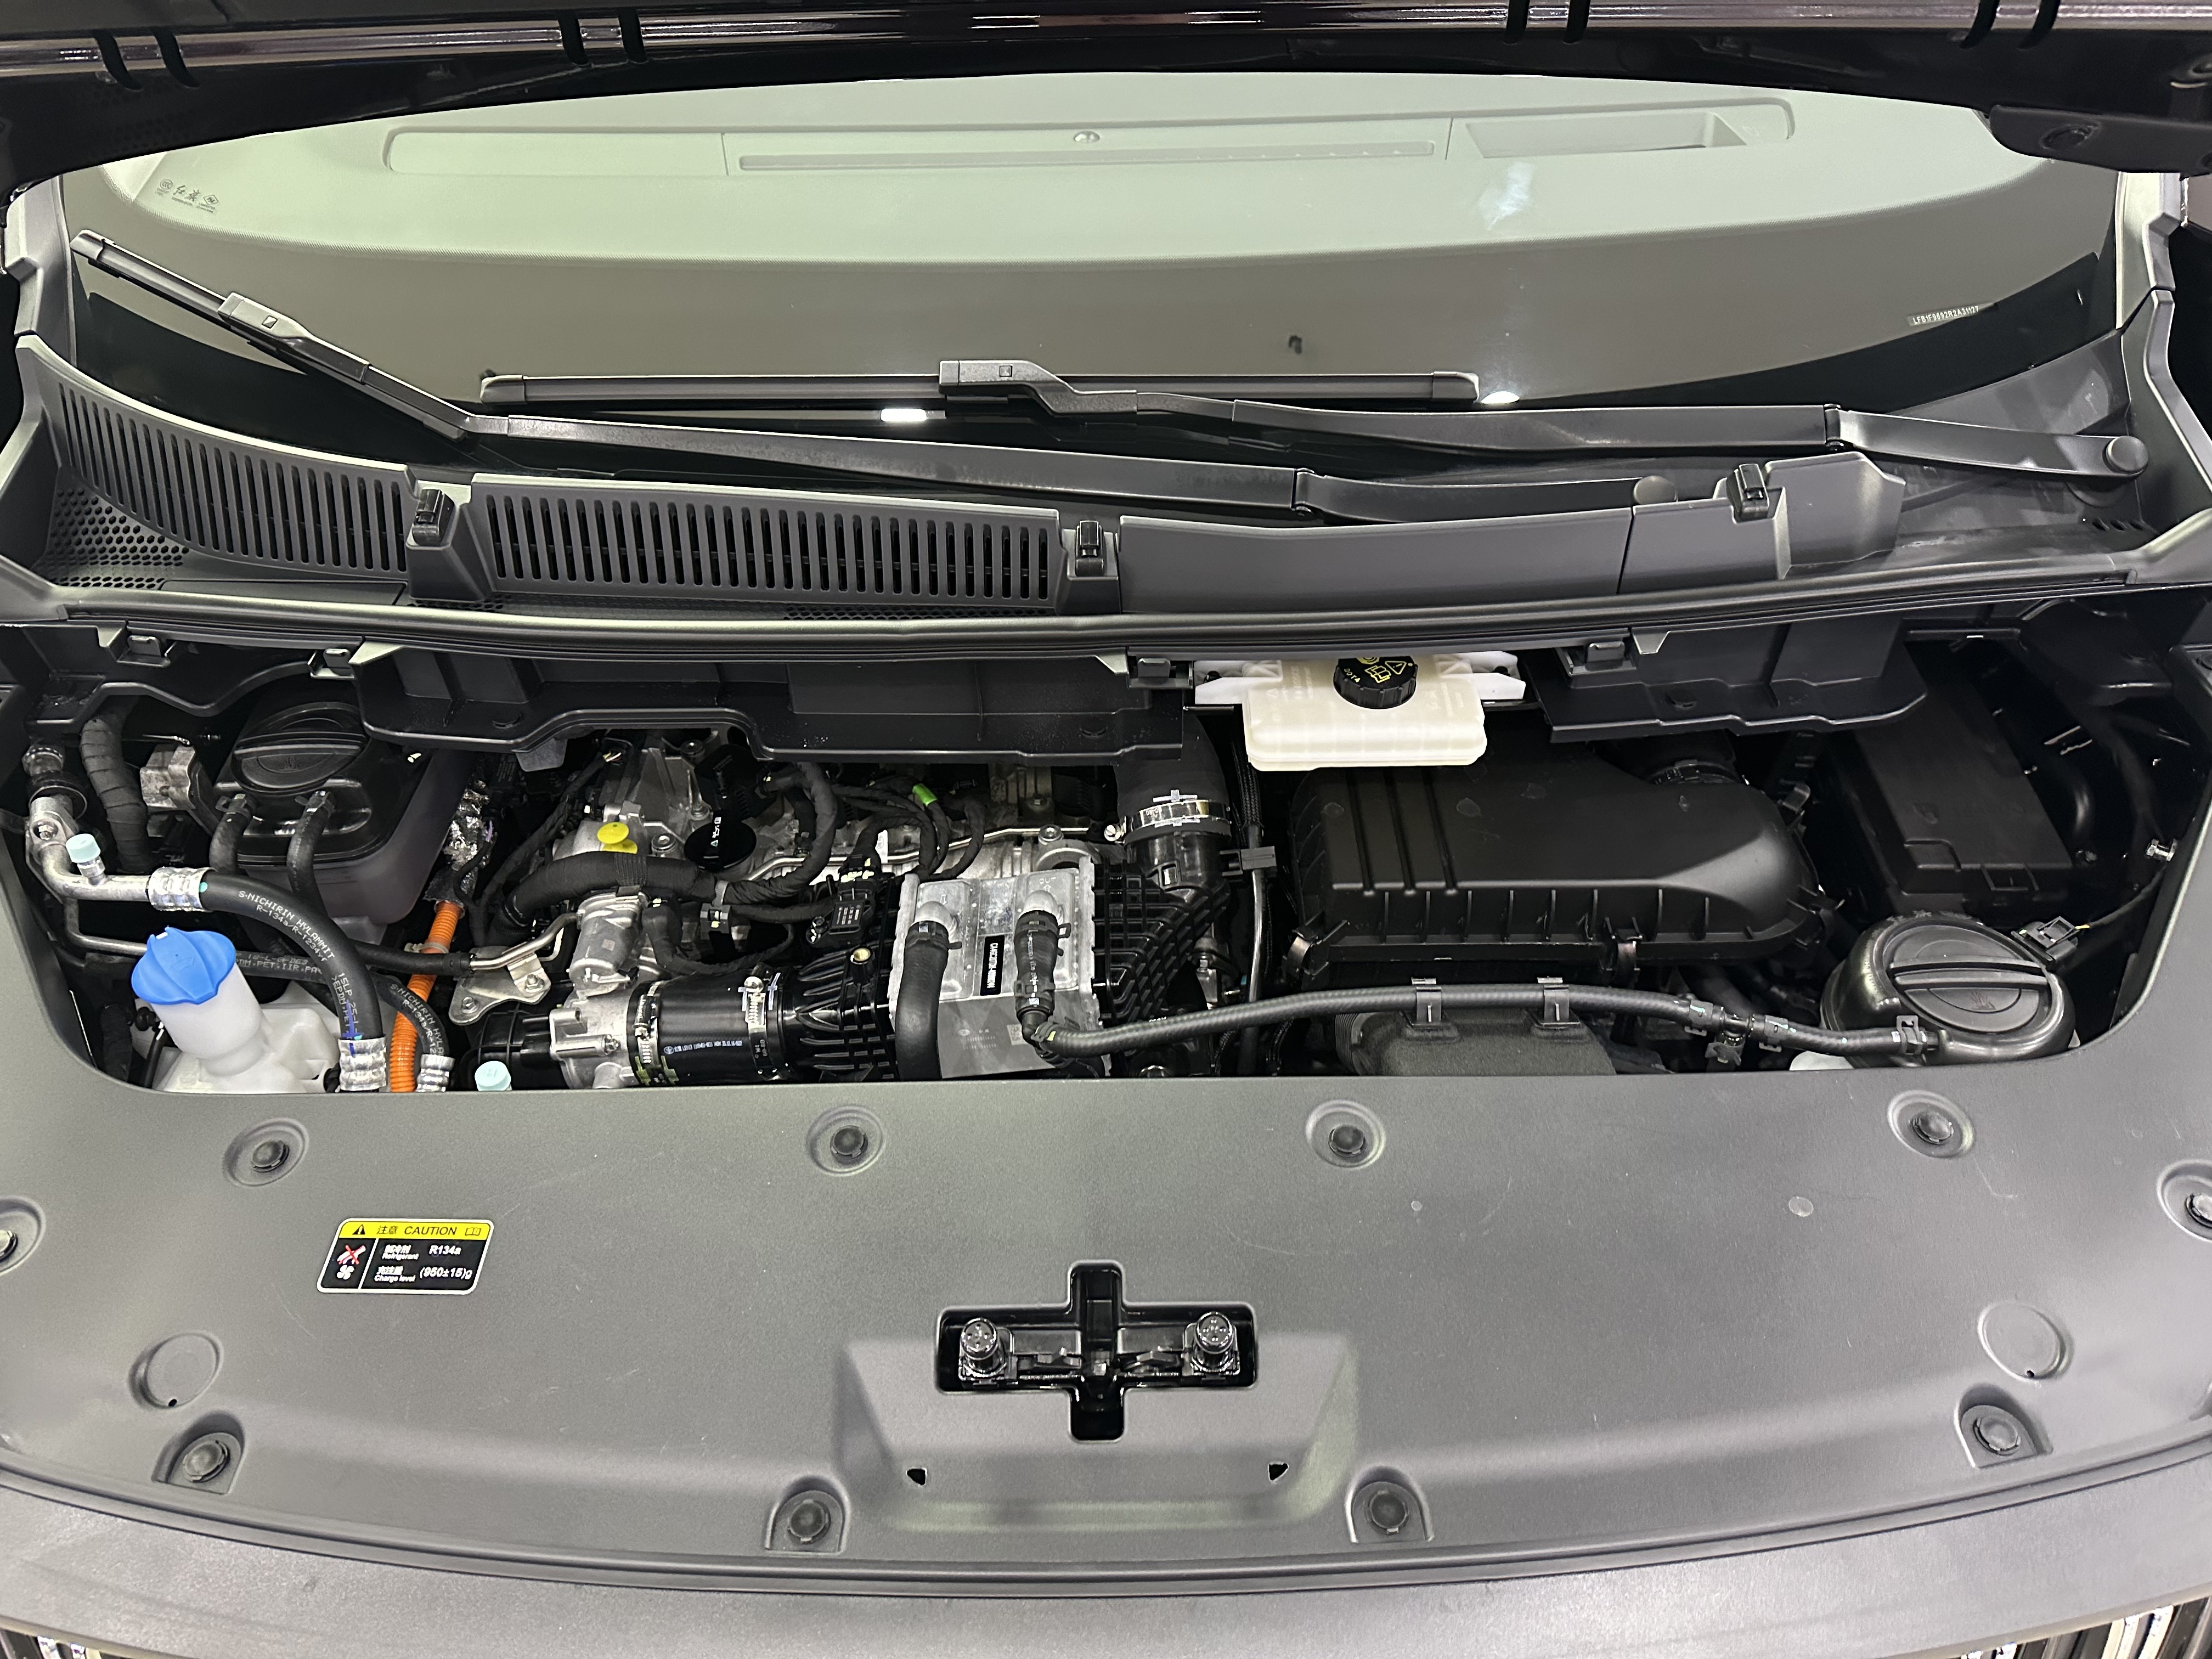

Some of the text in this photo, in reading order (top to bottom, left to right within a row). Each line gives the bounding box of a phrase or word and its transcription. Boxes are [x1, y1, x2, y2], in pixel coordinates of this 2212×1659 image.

[296, 919, 335, 959] HYLAMMIT
[376, 1226, 398, 1235] 注意
[404, 1226, 458, 1235] CAUTION
[429, 1245, 462, 1255] R134a
[382, 1252, 419, 1261] Refrigerant
[419, 1267, 473, 1280] (950±15)g
[374, 1274, 399, 1283] Charge
